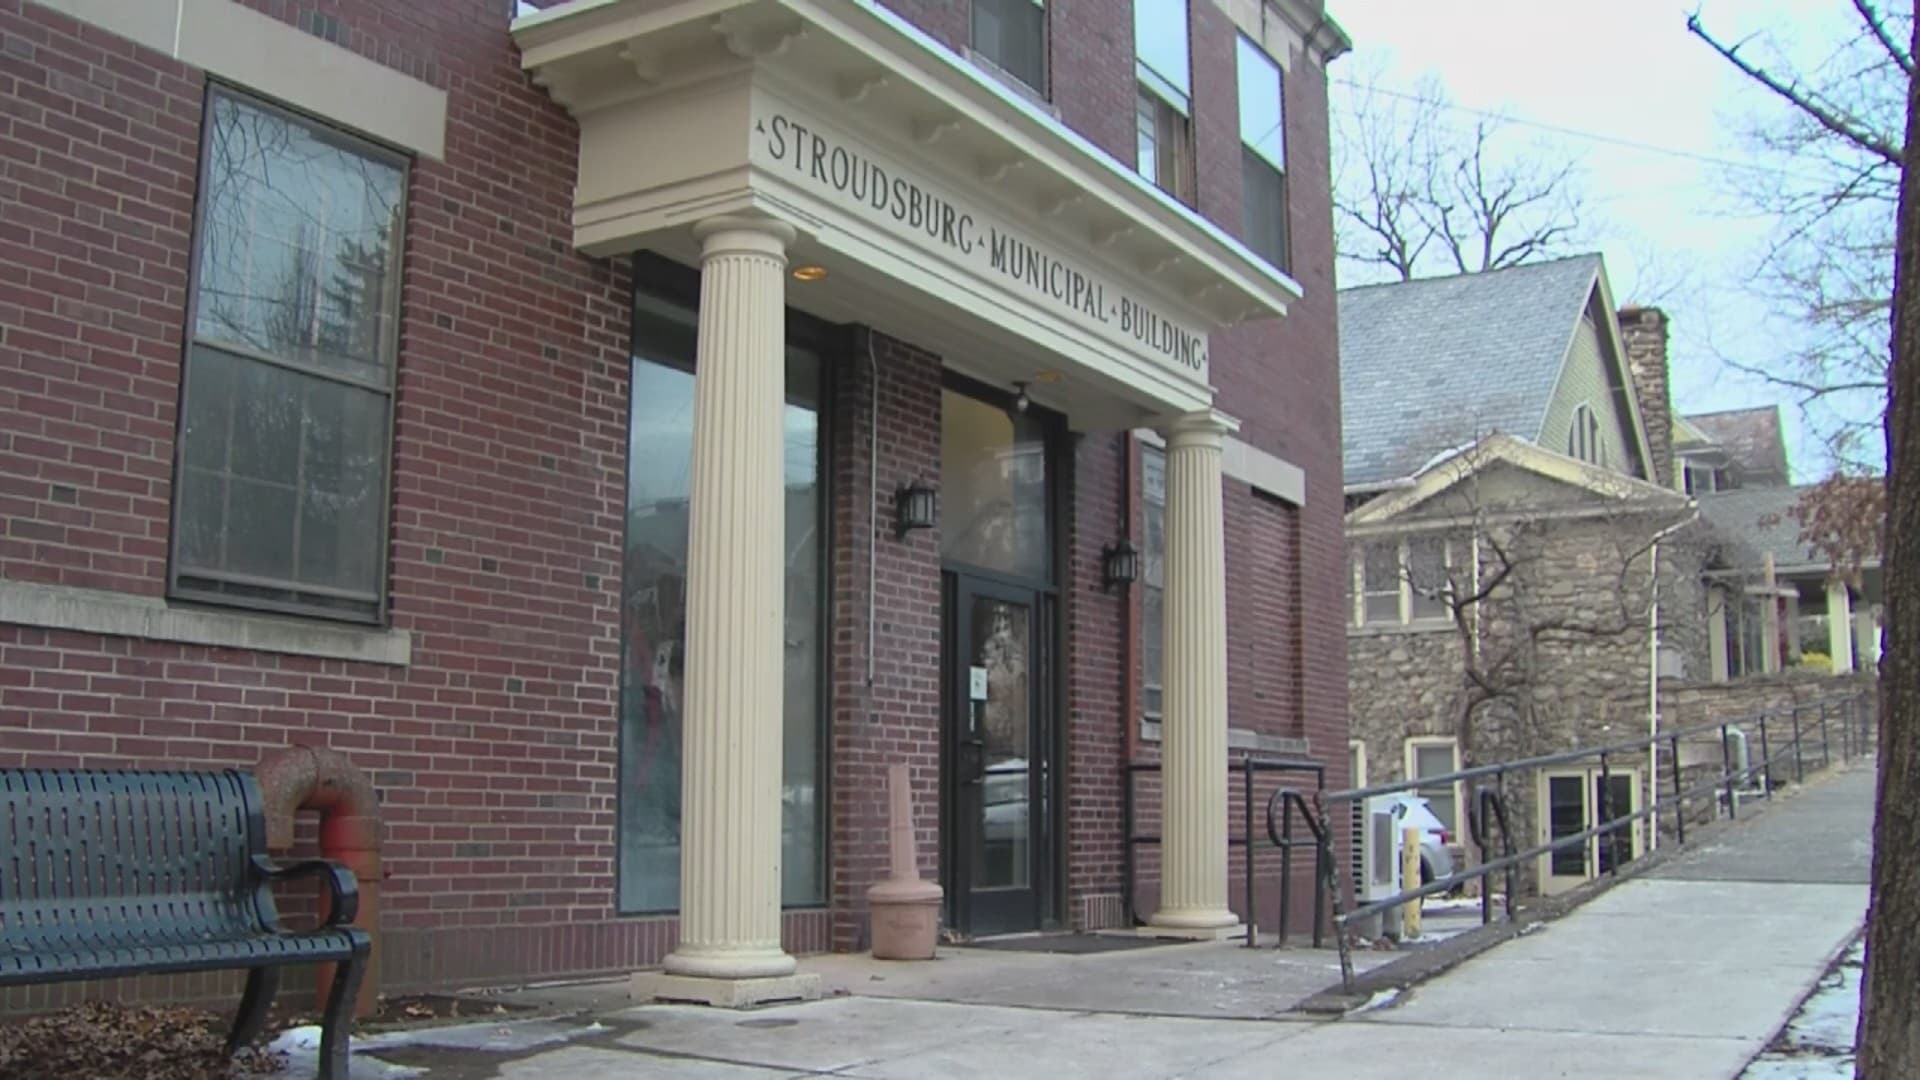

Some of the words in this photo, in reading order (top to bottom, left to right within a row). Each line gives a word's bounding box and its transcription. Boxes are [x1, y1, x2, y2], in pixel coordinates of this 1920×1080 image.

[769, 115, 973, 255] STROUDSBURG
[991, 228, 1108, 323] MUNICIPAL
[1121, 296, 1201, 370] BUILDING
